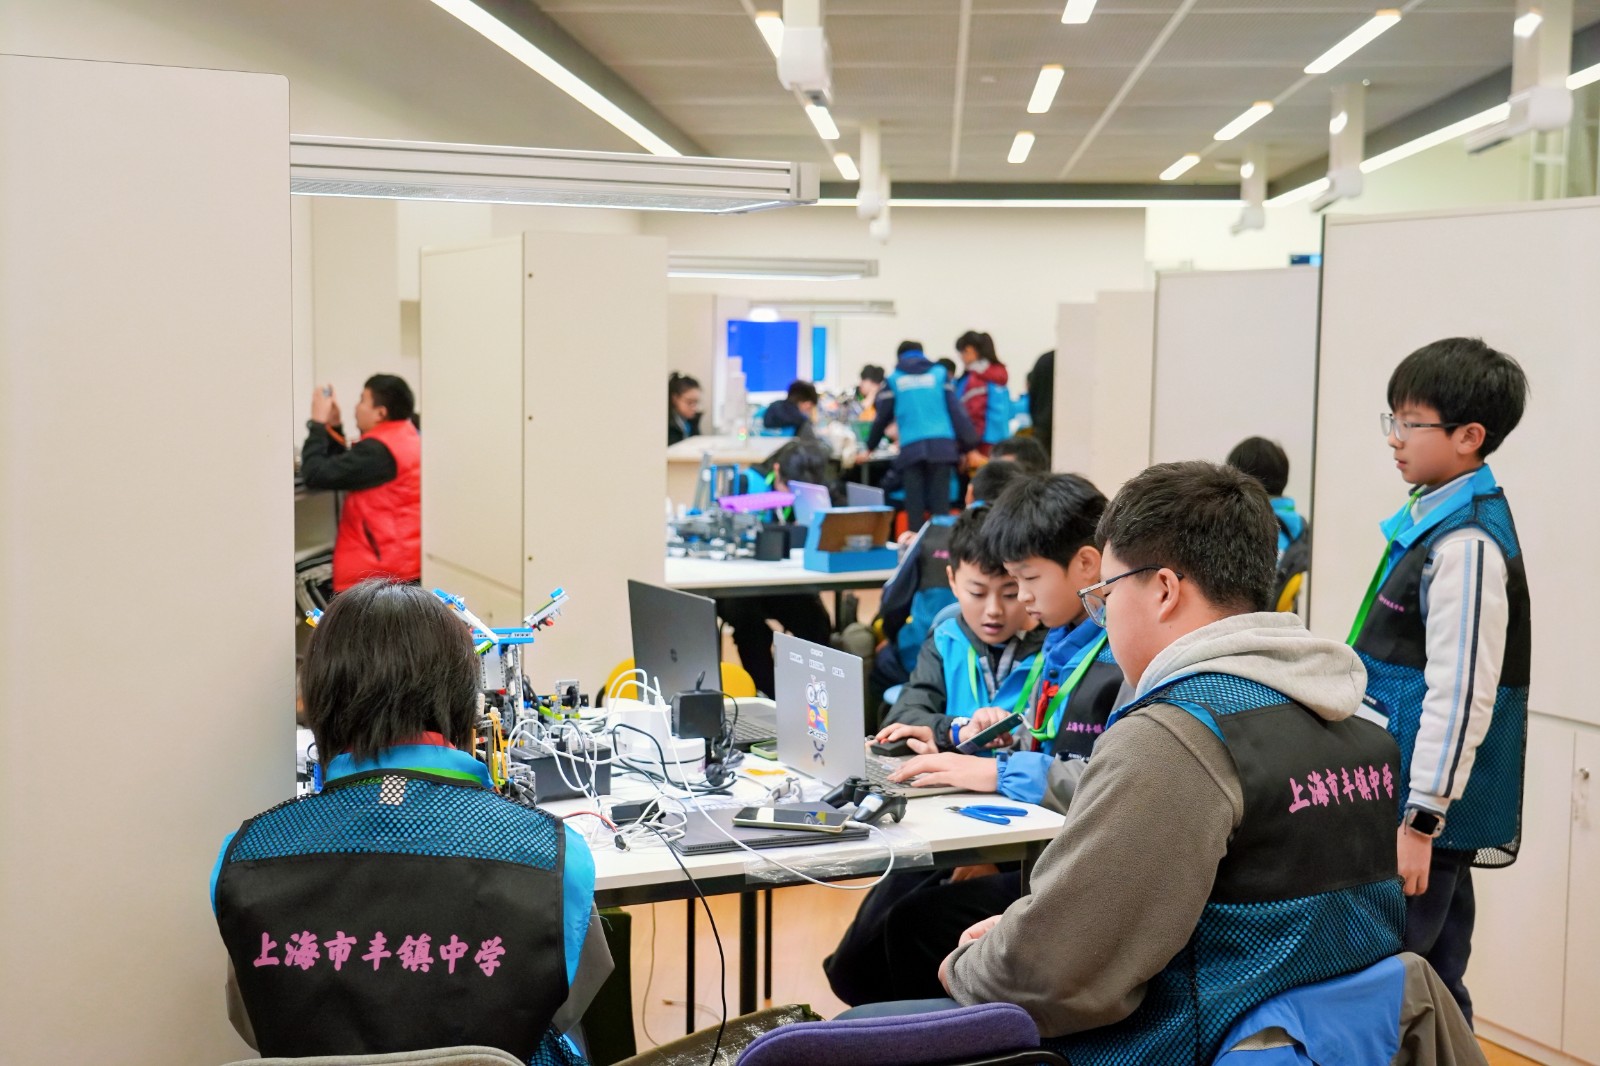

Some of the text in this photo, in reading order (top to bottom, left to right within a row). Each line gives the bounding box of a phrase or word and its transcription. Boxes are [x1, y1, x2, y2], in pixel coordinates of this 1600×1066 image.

[1288, 763, 1394, 813] 上海市丰镇中学
[253, 930, 506, 977] 上海市丰镇中学
